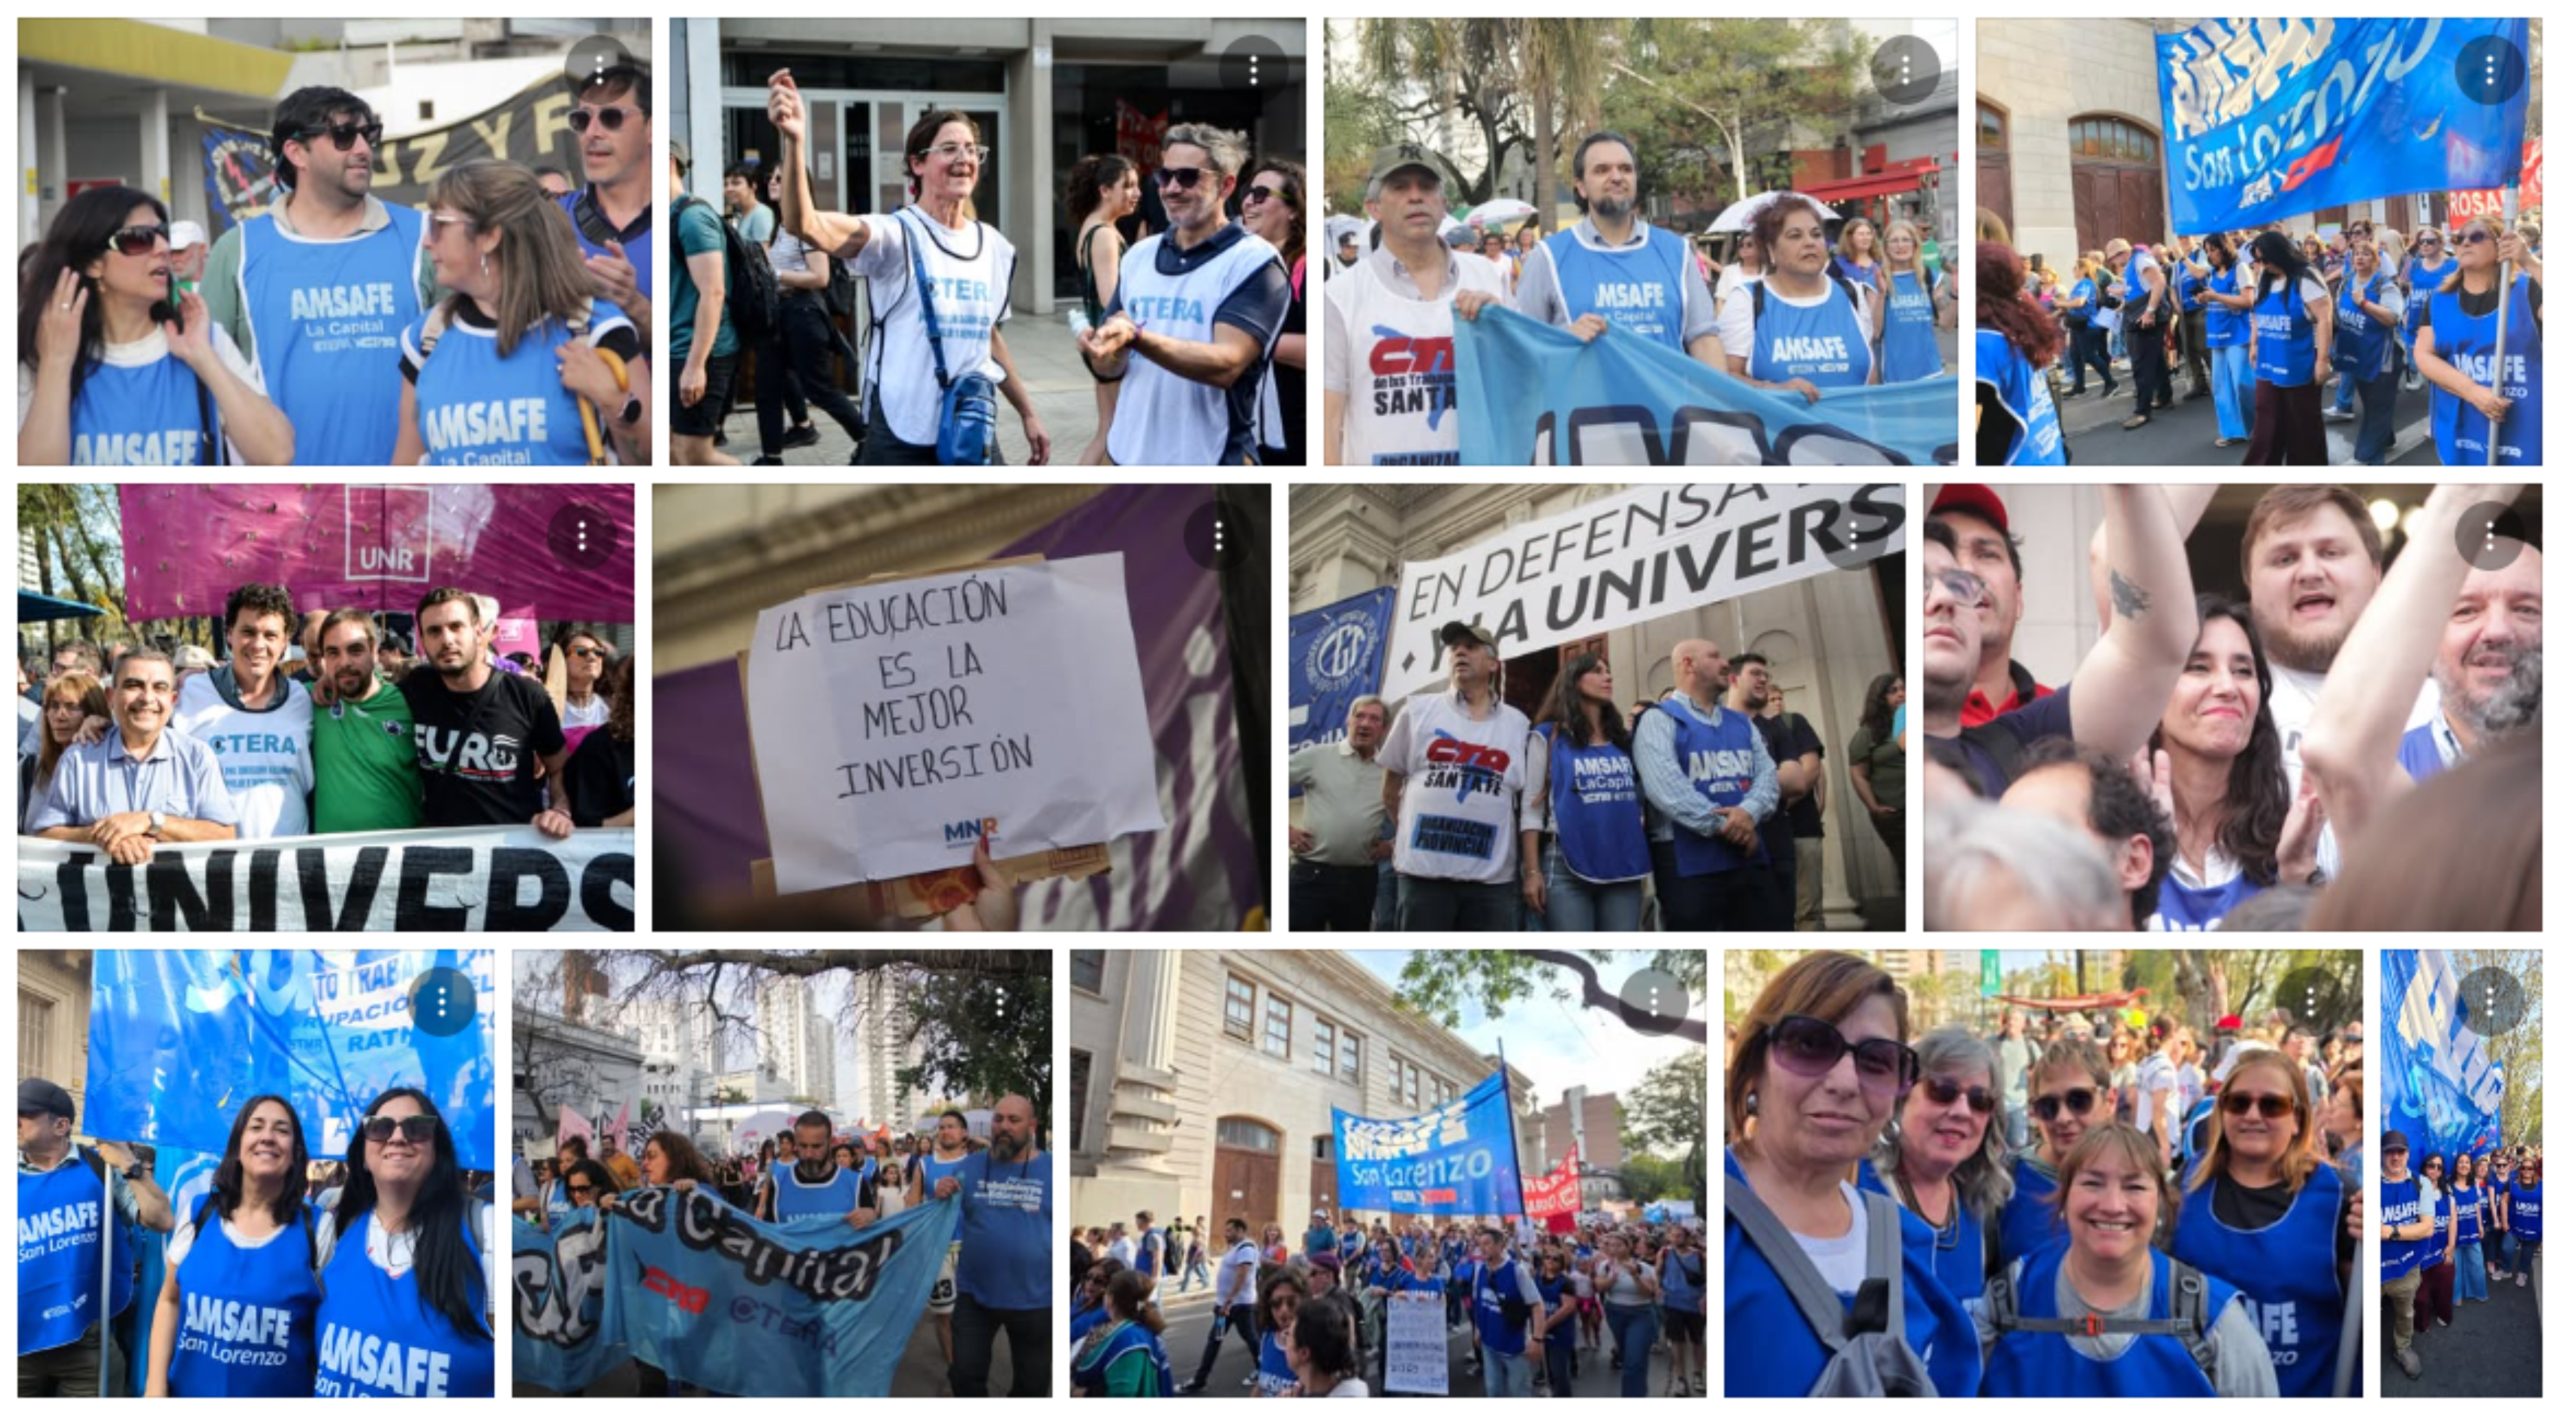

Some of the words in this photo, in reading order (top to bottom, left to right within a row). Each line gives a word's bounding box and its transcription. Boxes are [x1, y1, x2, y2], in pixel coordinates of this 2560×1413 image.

[2184, 143, 2234, 191] San
[291, 282, 395, 320] AMSAFE
[329, 319, 384, 337] Capital
[1772, 336, 1849, 364] AMSAFE
[427, 397, 547, 452] AMSAFE
[73, 430, 197, 465] AMSAFE
[360, 547, 414, 571] UNR
[1408, 564, 1469, 622] EN
[1477, 484, 1769, 598] DEFENSA
[1545, 484, 1906, 631] UNIVERS
[776, 612, 810, 652] LA
[878, 652, 915, 690] ES
[947, 642, 984, 679] LA
[863, 685, 973, 740] MEJOR
[208, 734, 297, 755] CTERA
[18, 1200, 98, 1246] AMSAFE
[18, 1244, 45, 1263] San
[49, 1231, 98, 1253] Lorenzo
[184, 1291, 292, 1349] AMSAFE
[178, 1331, 209, 1354] San
[211, 1341, 288, 1366] Lorenzo
[319, 1322, 451, 1397] AMSAFE
